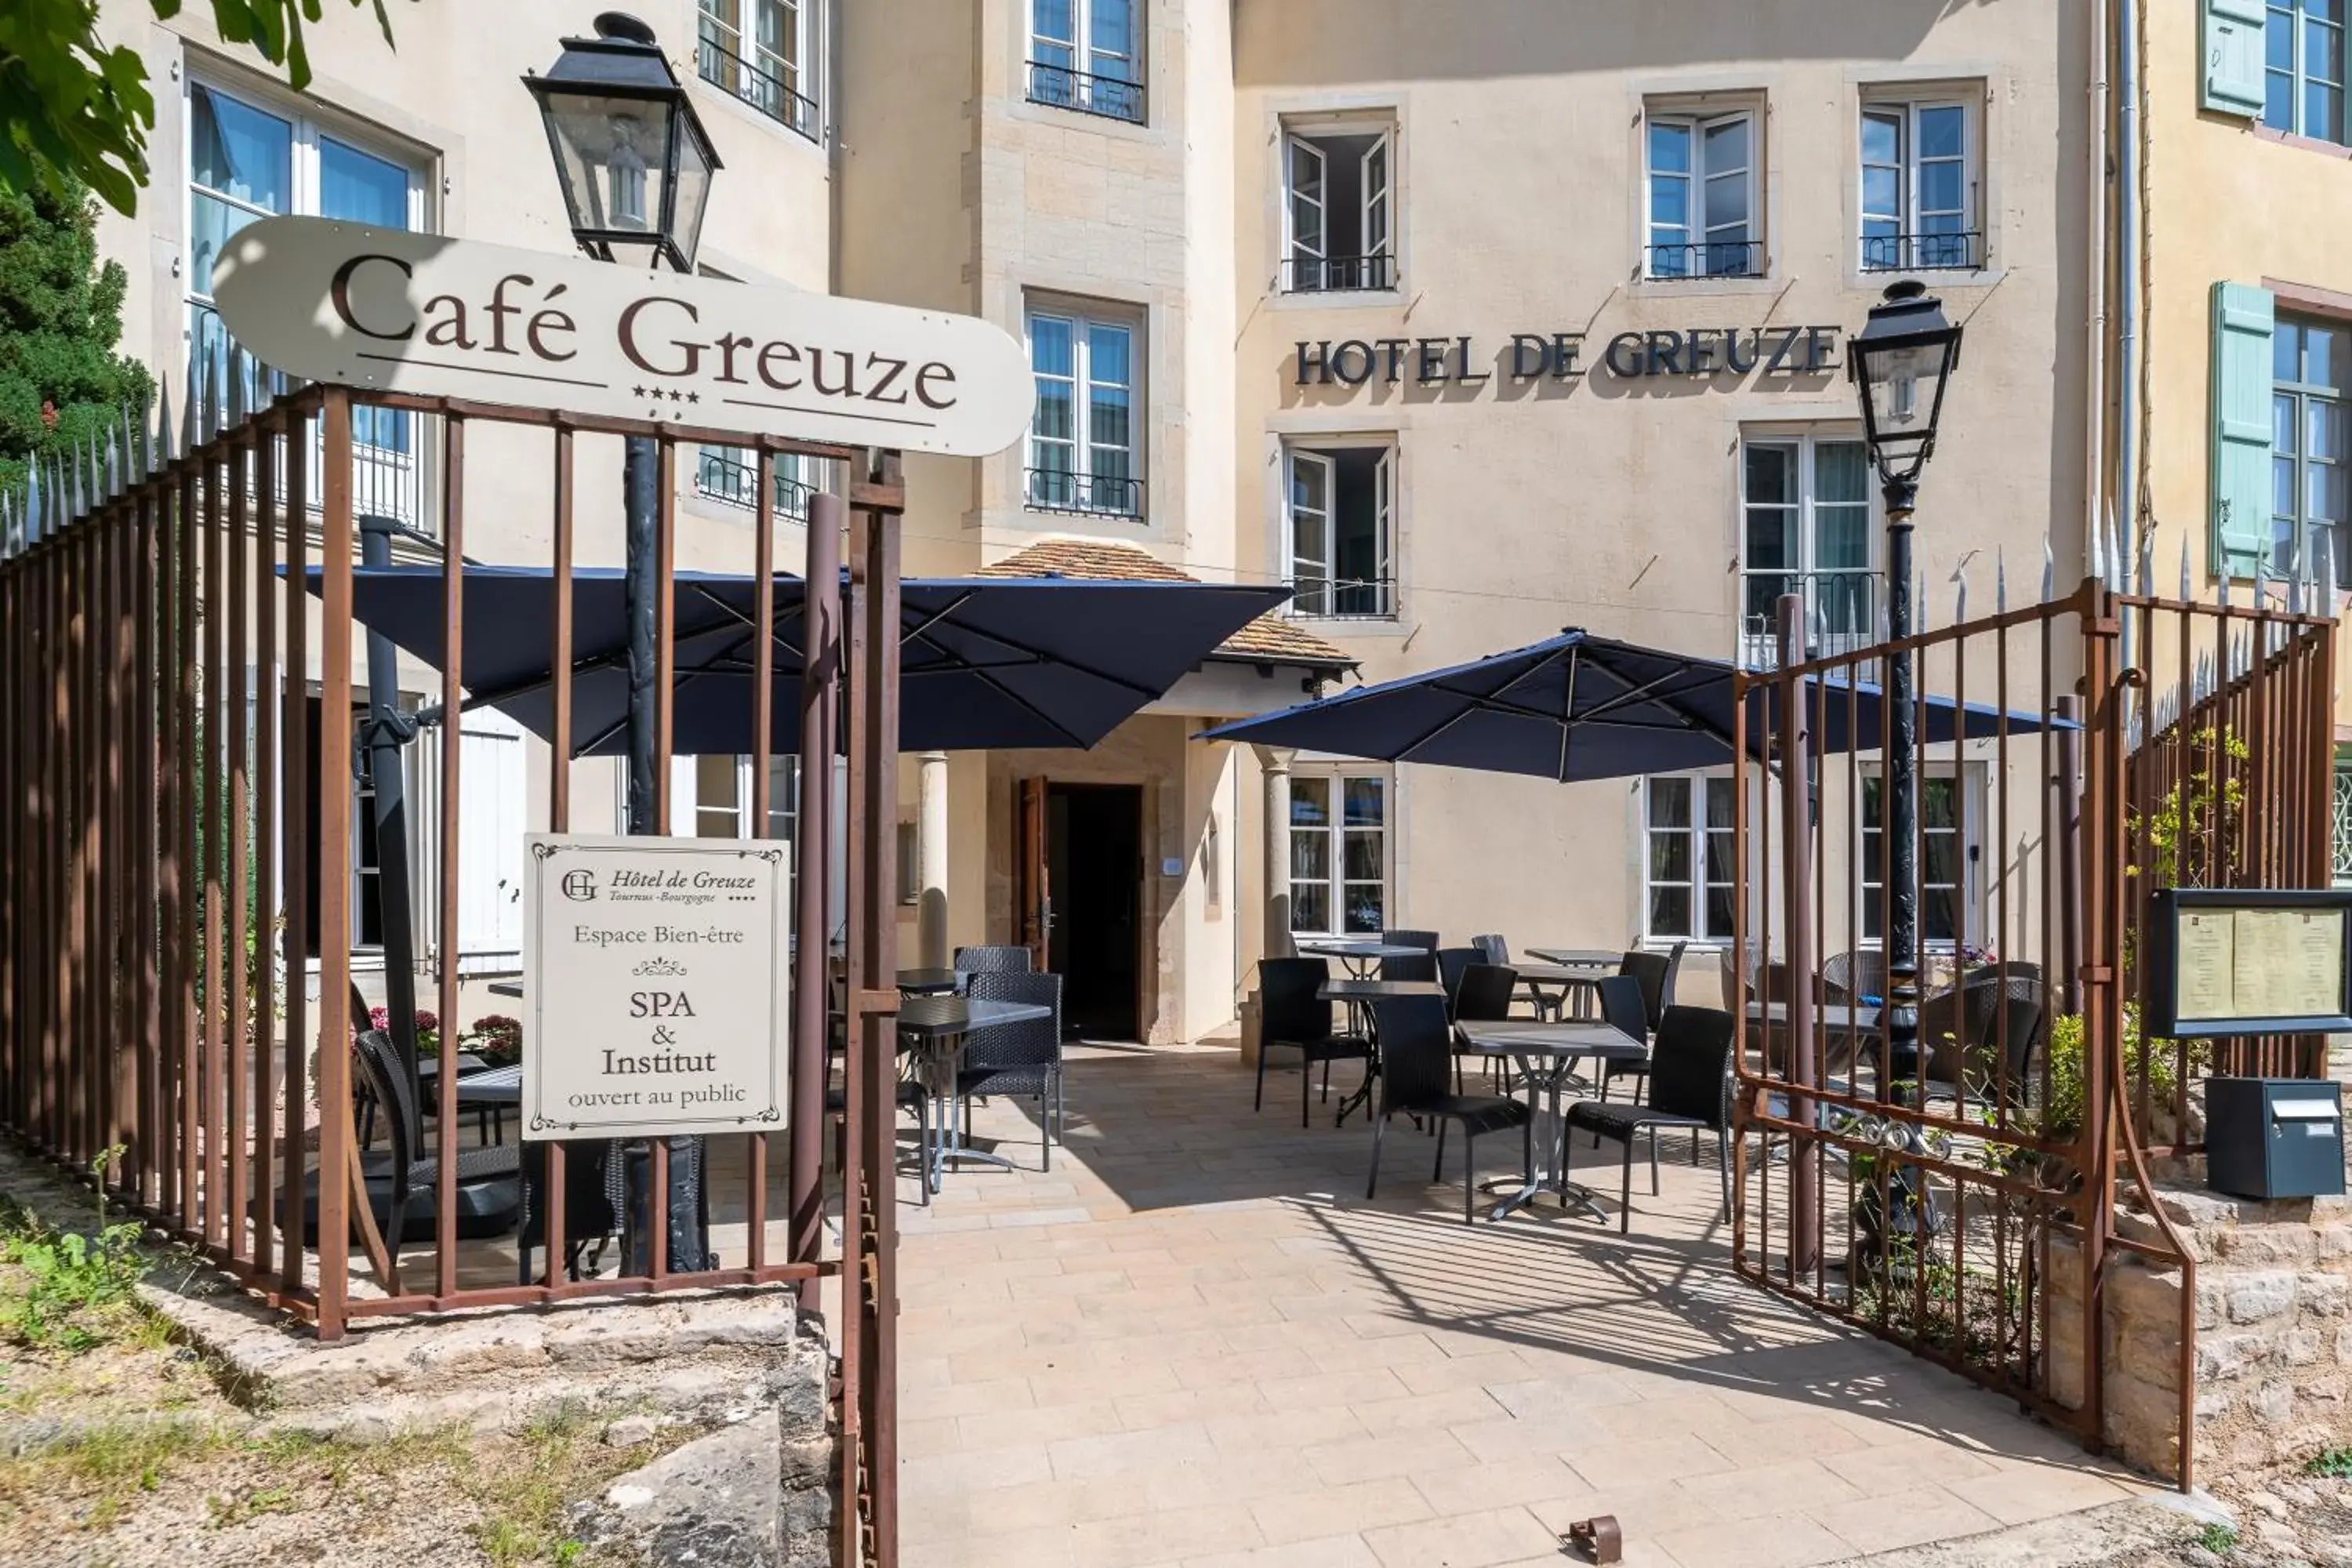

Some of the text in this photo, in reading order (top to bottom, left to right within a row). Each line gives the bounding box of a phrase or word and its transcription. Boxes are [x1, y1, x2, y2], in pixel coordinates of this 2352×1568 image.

[330, 253, 957, 410] Café Greuze
[1294, 325, 1842, 386] HOTEL DE GREUZE
[611, 869, 757, 889] Hôtel de Greuze
[609, 891, 654, 902] Tournus
[574, 924, 745, 948] Espace Bien-être
[630, 991, 696, 1018] SPA
[652, 1025, 677, 1045] &
[601, 1047, 717, 1075] Institut
[568, 1084, 746, 1109] ouvert au public
